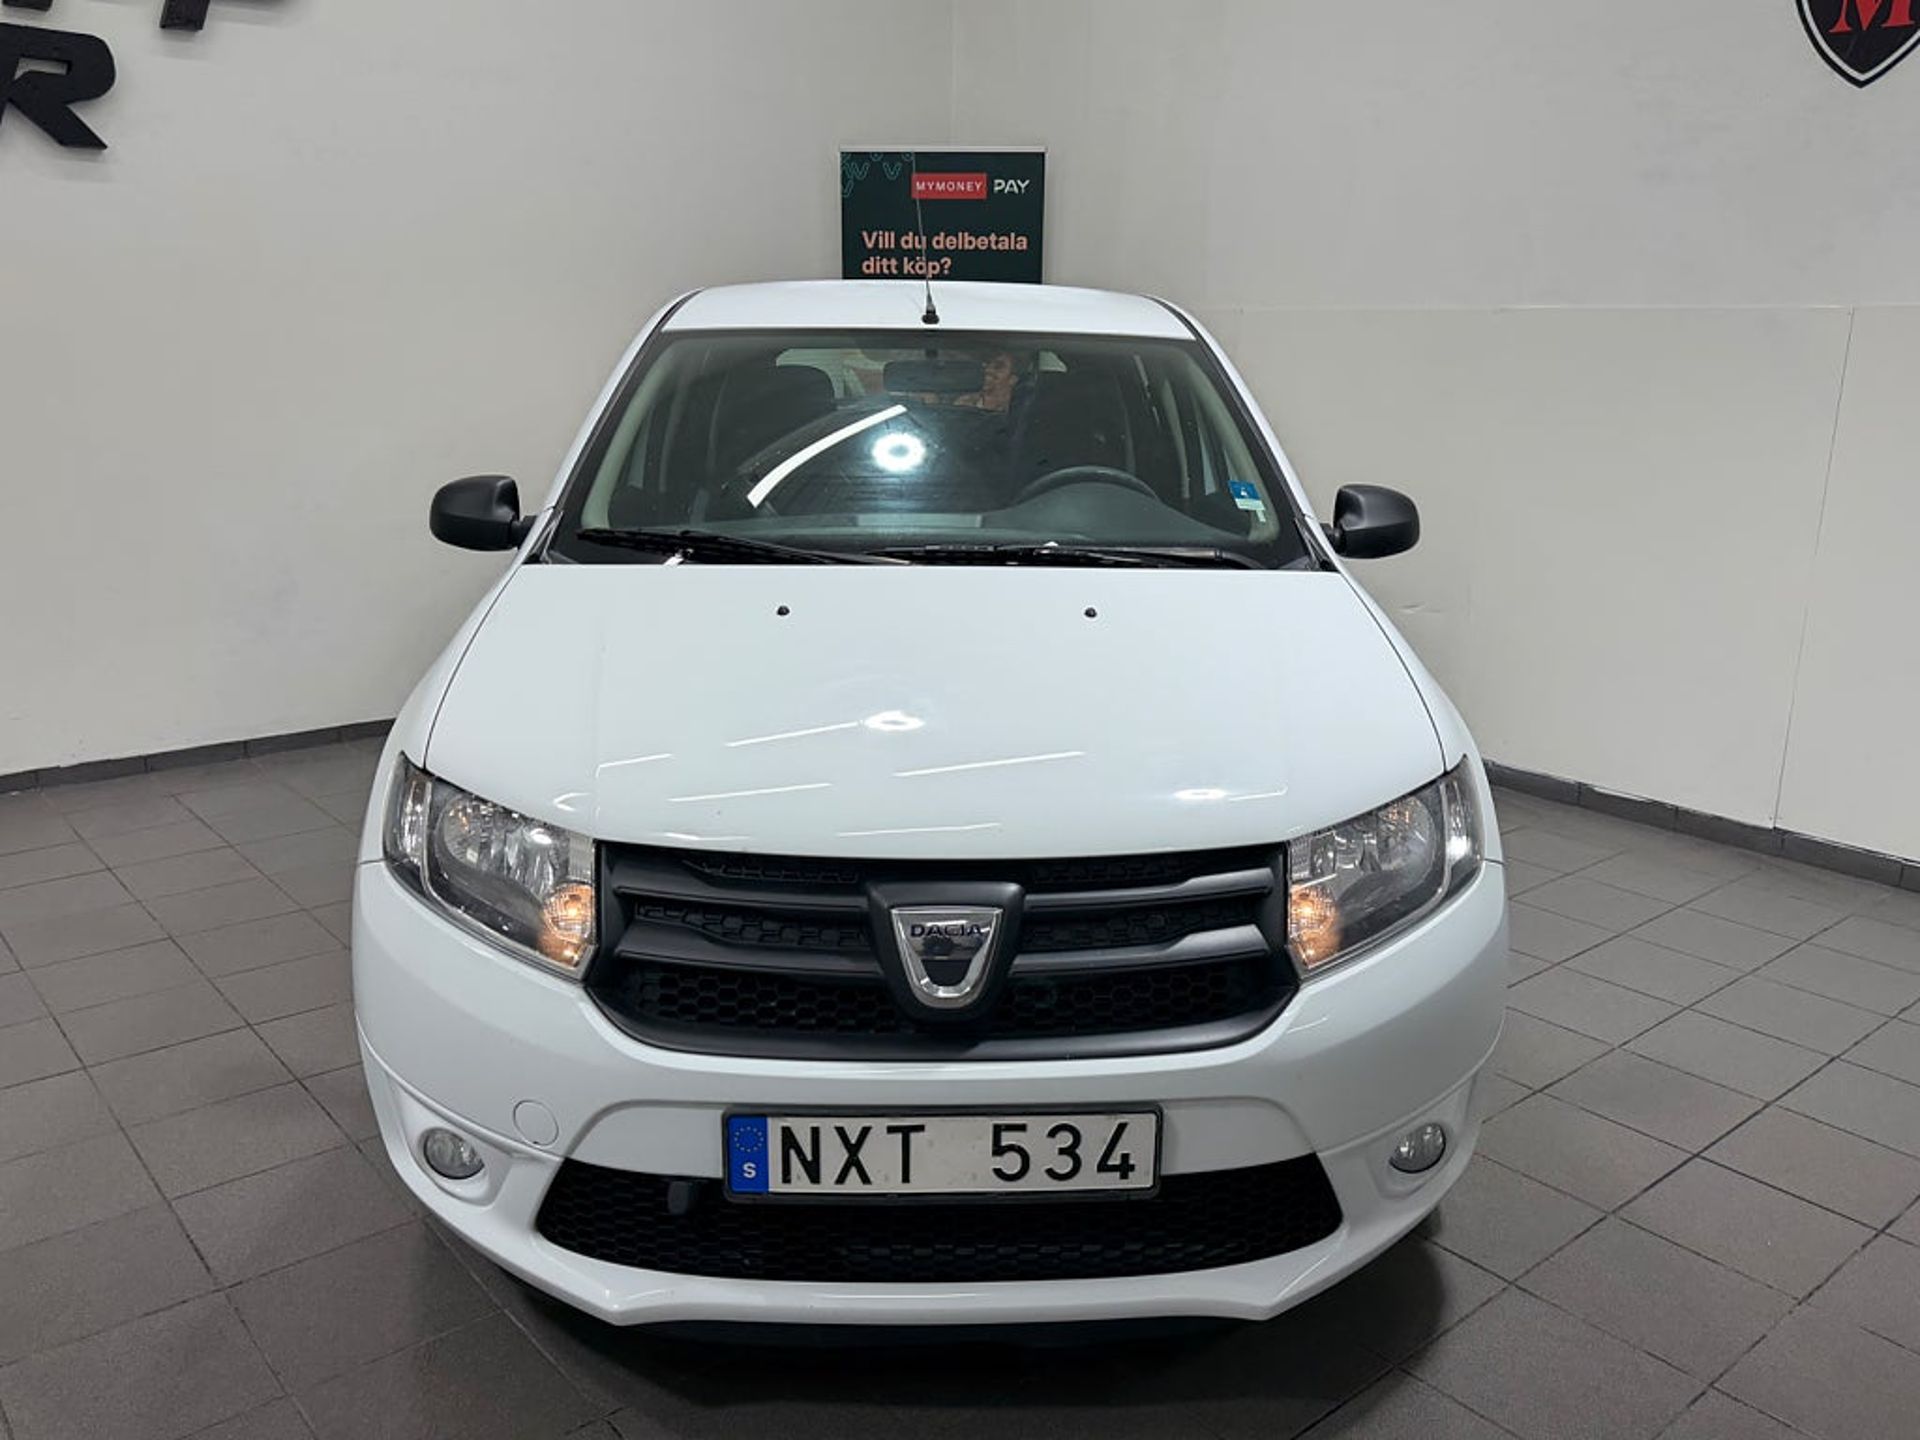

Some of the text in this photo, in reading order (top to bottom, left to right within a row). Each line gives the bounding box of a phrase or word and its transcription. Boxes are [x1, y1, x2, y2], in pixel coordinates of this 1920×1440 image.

[915, 179, 1030, 194] MYMONEY PAY
[862, 230, 1028, 250] Vill du delbetala
[861, 255, 952, 278] ditt köp?
[910, 923, 984, 937] DACIA
[742, 1121, 1136, 1185] S NXT 534
